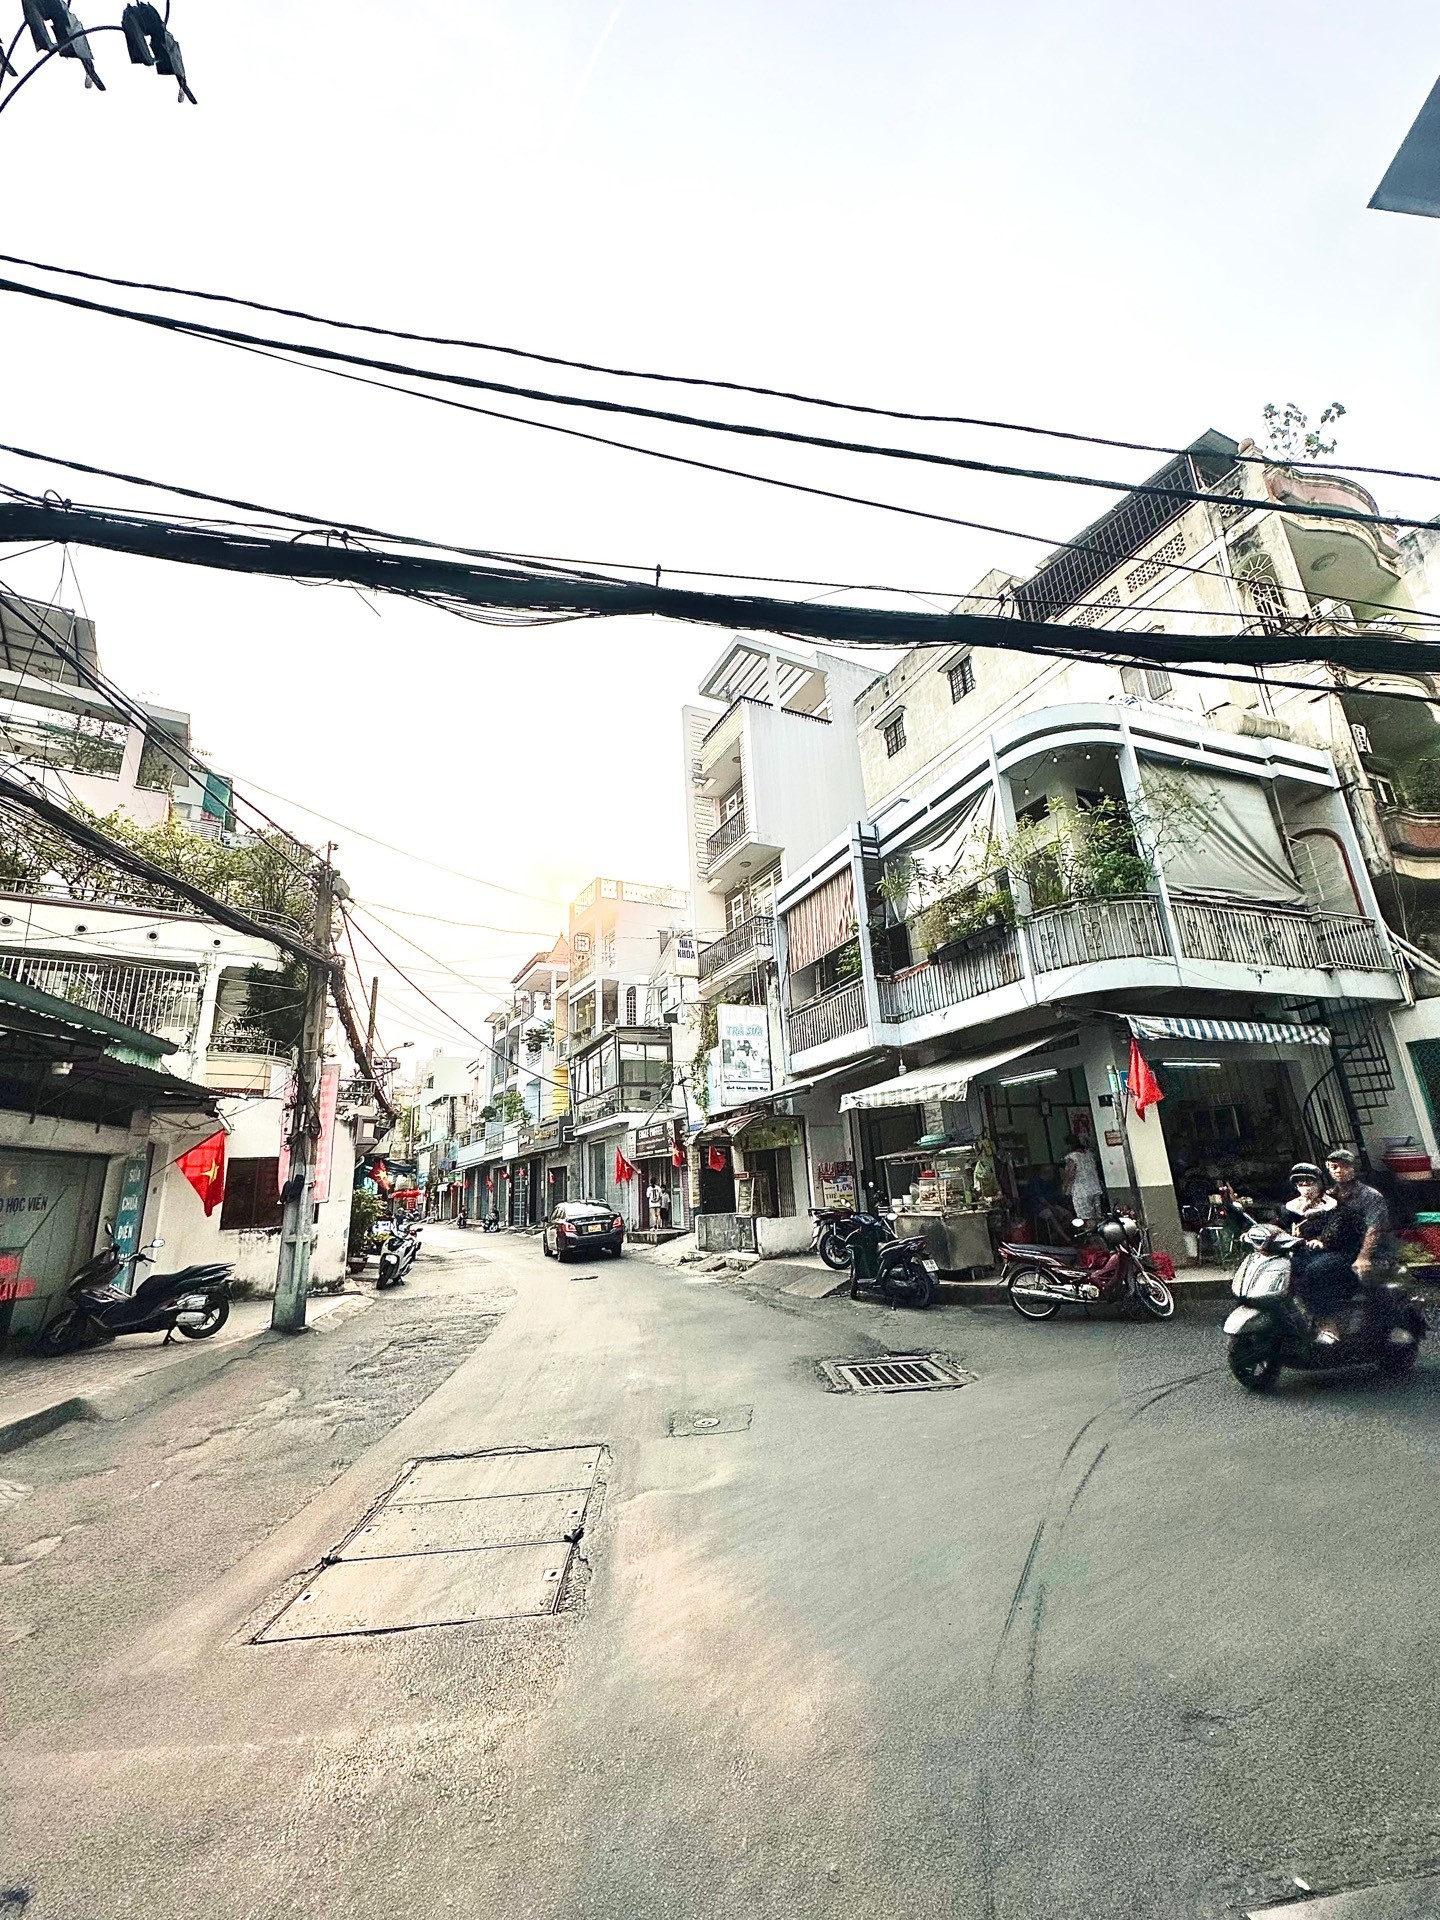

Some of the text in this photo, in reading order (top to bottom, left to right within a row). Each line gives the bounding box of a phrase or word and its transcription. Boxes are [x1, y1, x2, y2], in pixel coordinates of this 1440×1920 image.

[679, 939, 693, 949] NHA
[677, 949, 696, 959] KHOA
[726, 1023, 745, 1037] TRÀ
[5, 1196, 26, 1215] HỌC
